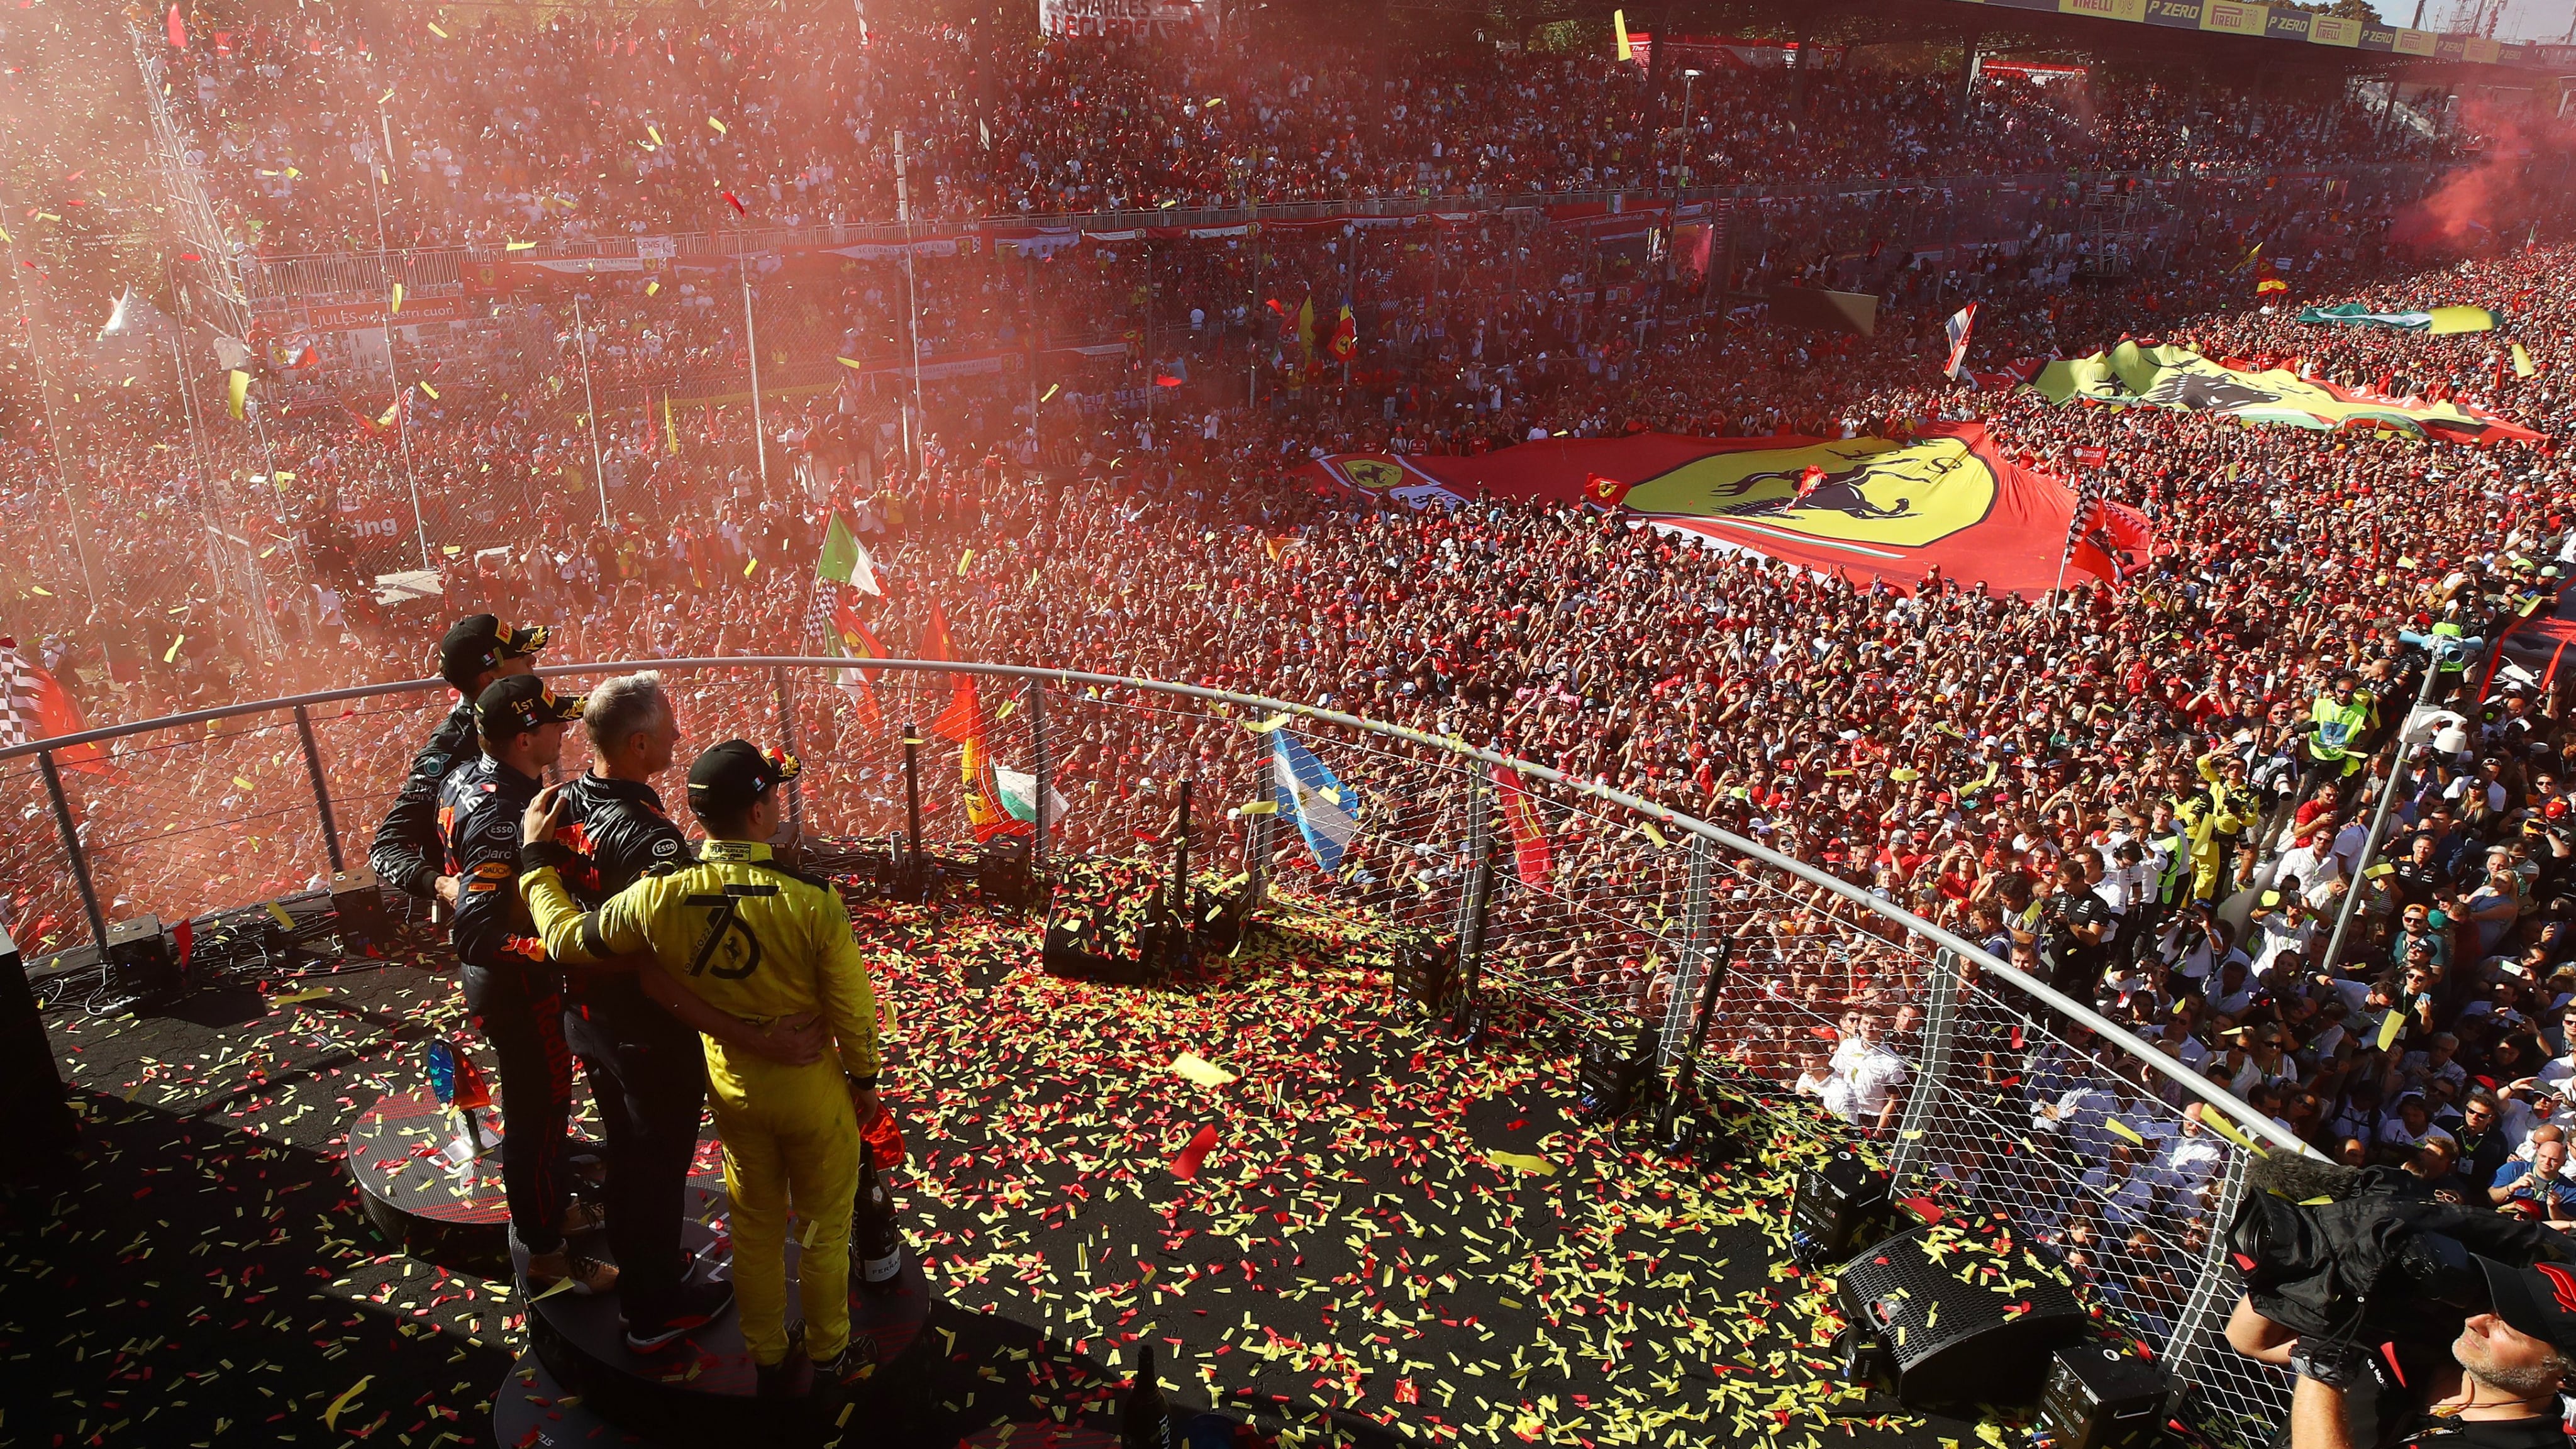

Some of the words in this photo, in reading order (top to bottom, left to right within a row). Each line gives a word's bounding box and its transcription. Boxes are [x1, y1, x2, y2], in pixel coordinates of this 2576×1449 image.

[1064, 0, 1151, 17] CHARLES
[2148, 1, 2158, 14] P
[2160, 4, 2200, 20] ZERO
[2210, 4, 2244, 28] PIRELLI
[2267, 16, 2278, 28] P
[2277, 18, 2309, 33] ZERO
[2361, 30, 2369, 41] P
[2368, 31, 2394, 44] ZERO
[2443, 42, 2464, 53] ZERO
[316, 312, 358, 328] JULES
[423, 305, 455, 318] cuori
[477, 845, 512, 860] Claro
[482, 866, 508, 875] RAUCH
